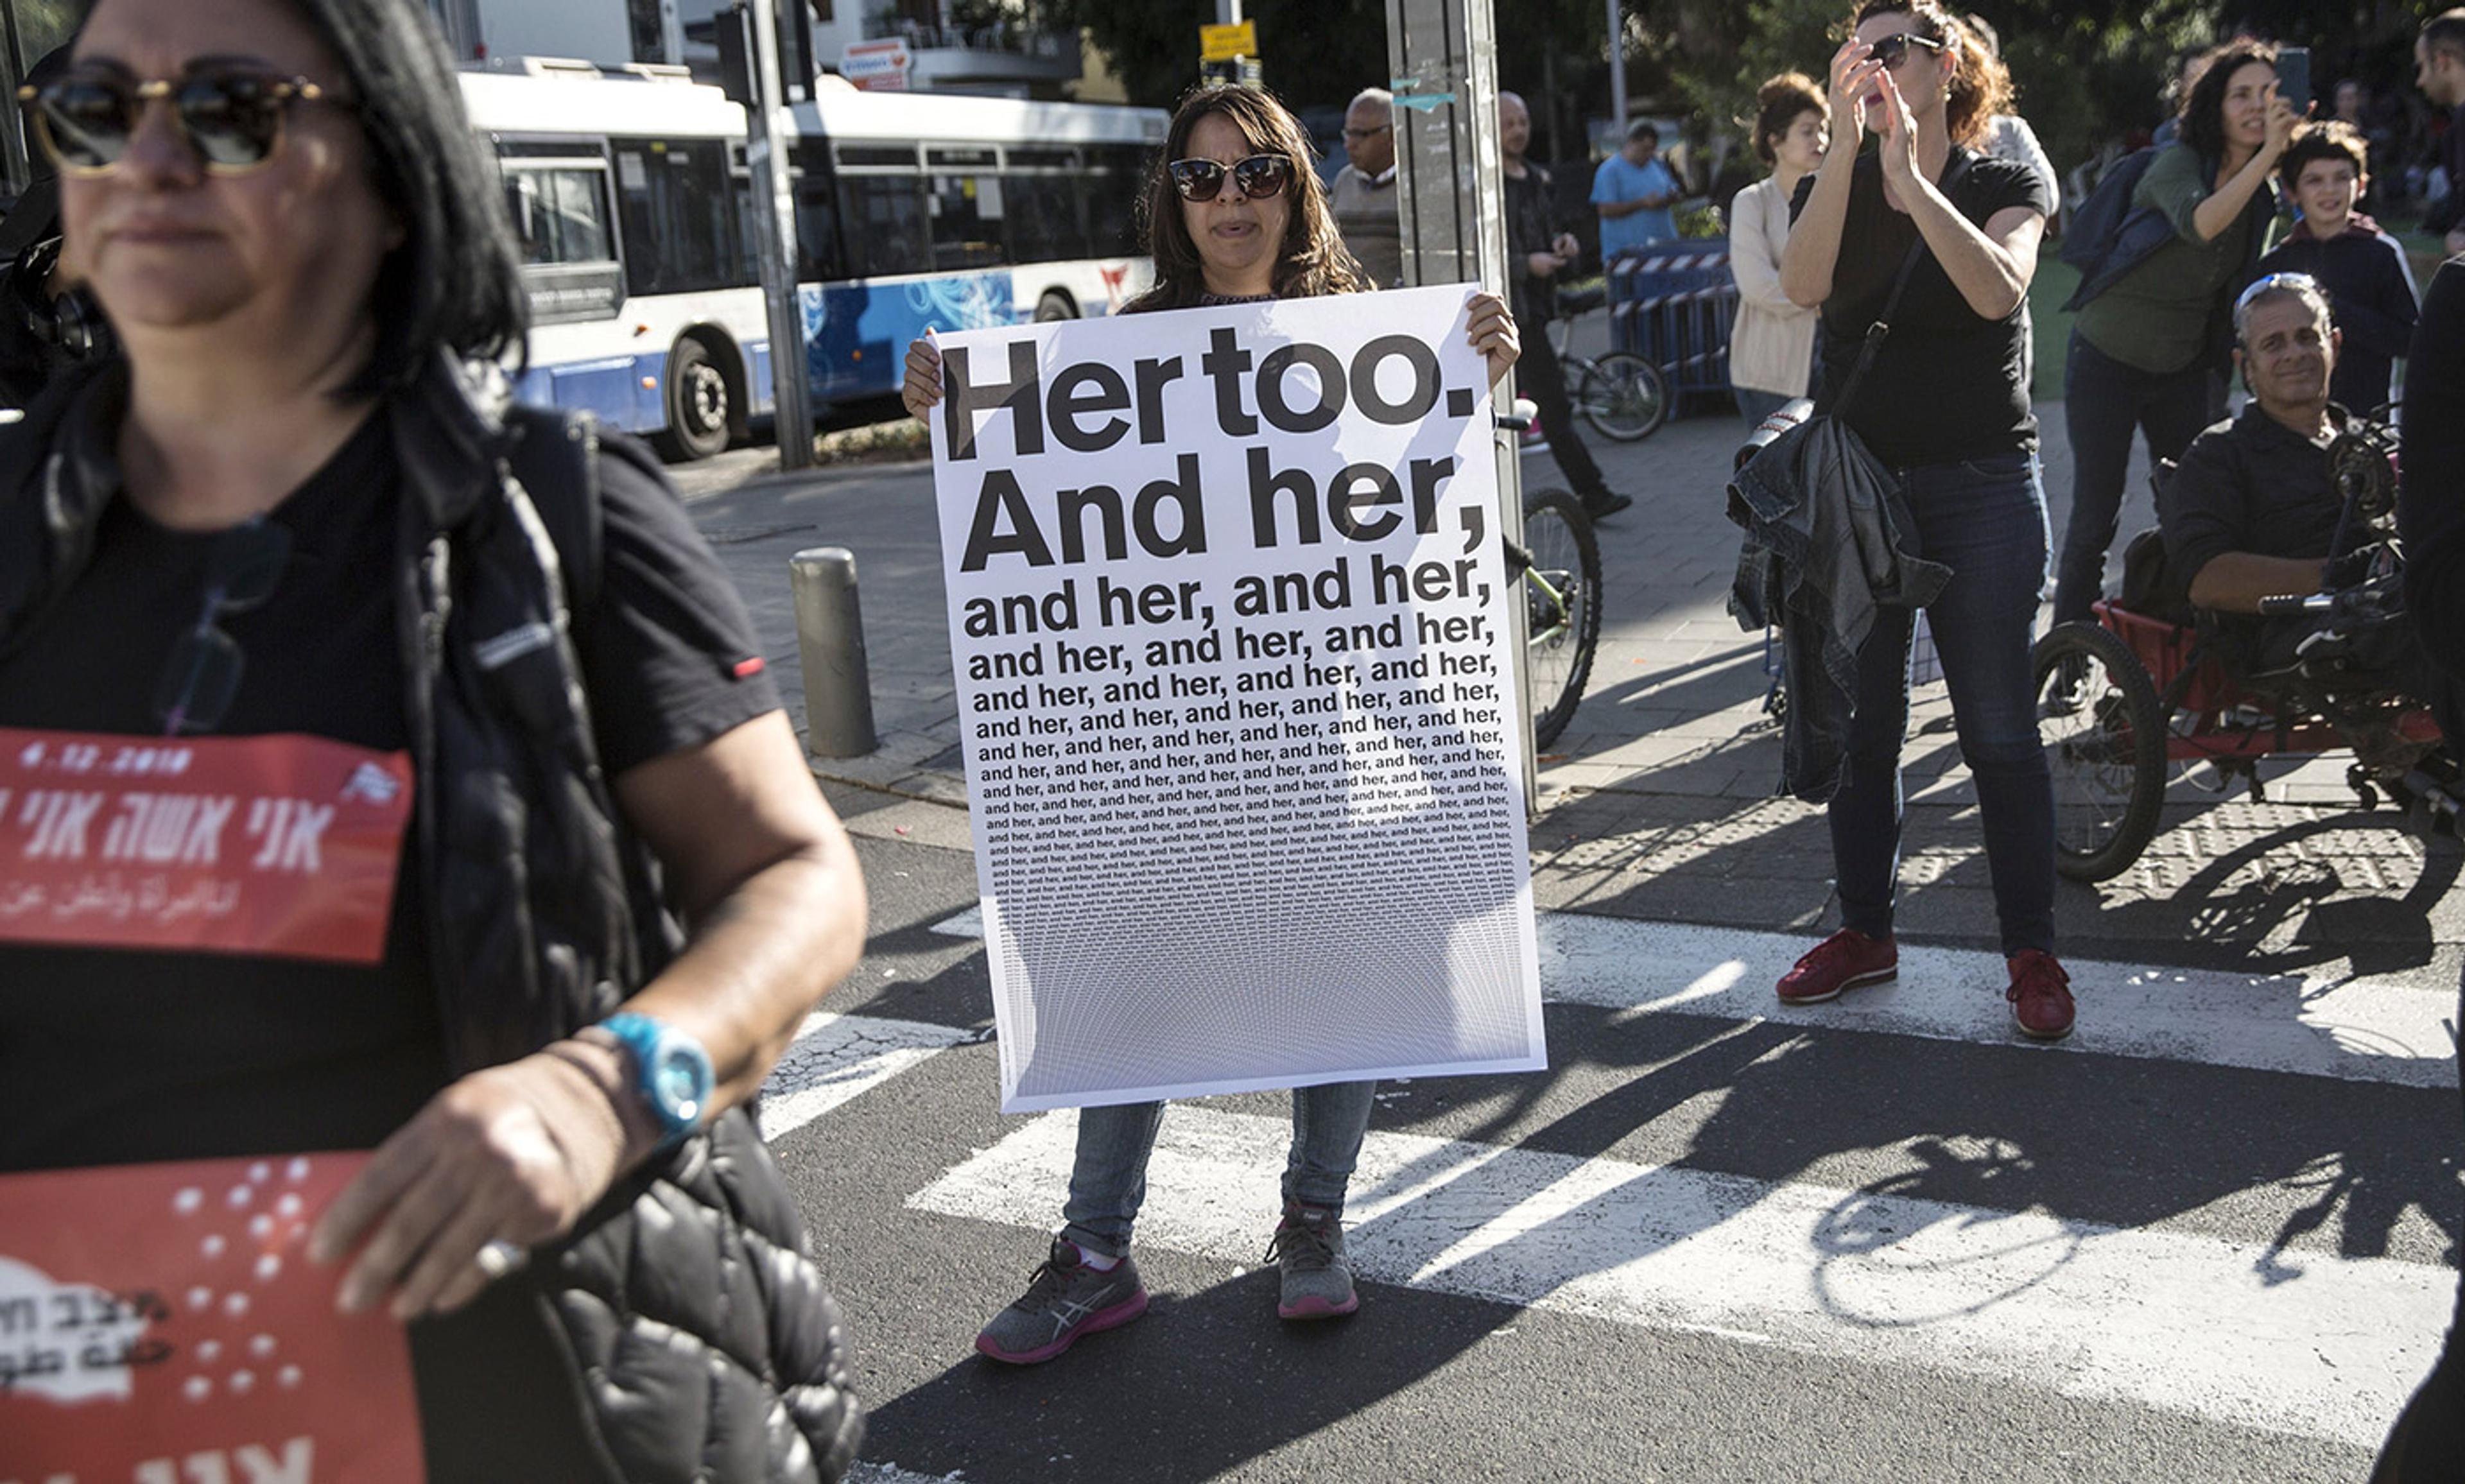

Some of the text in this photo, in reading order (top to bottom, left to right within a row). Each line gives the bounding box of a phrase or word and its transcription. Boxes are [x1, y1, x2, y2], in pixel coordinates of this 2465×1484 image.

[942, 328, 1475, 461] Her too.
[960, 447, 1484, 572] And her,
[964, 554, 1491, 637] and her, and her,
[969, 612, 1494, 680] and her, and her, and her,
[974, 651, 1496, 712] and her, and her, and her, and her,
[976, 682, 1499, 739] and her, and her, and her, and her, and her,
[979, 708, 1501, 761] and her, and her, and her, and her, and her, and her,
[981, 730, 1503, 782] and her, and her, and her, and her, and her, and her, and her,
[983, 748, 1505, 798] and her, and her, and her, and her, and her, and her, and her, and her,
[985, 766, 1506, 815] and her, and her, and her, and her, and her, and her, and her, and her, and her,
[987, 781, 1508, 829] and her, and her, and her, and her, and her, and her, and her, and her, and her, and her,
[19, 789, 103, 859] אני
[102, 792, 236, 865] אשה
[247, 797, 335, 873] אני
